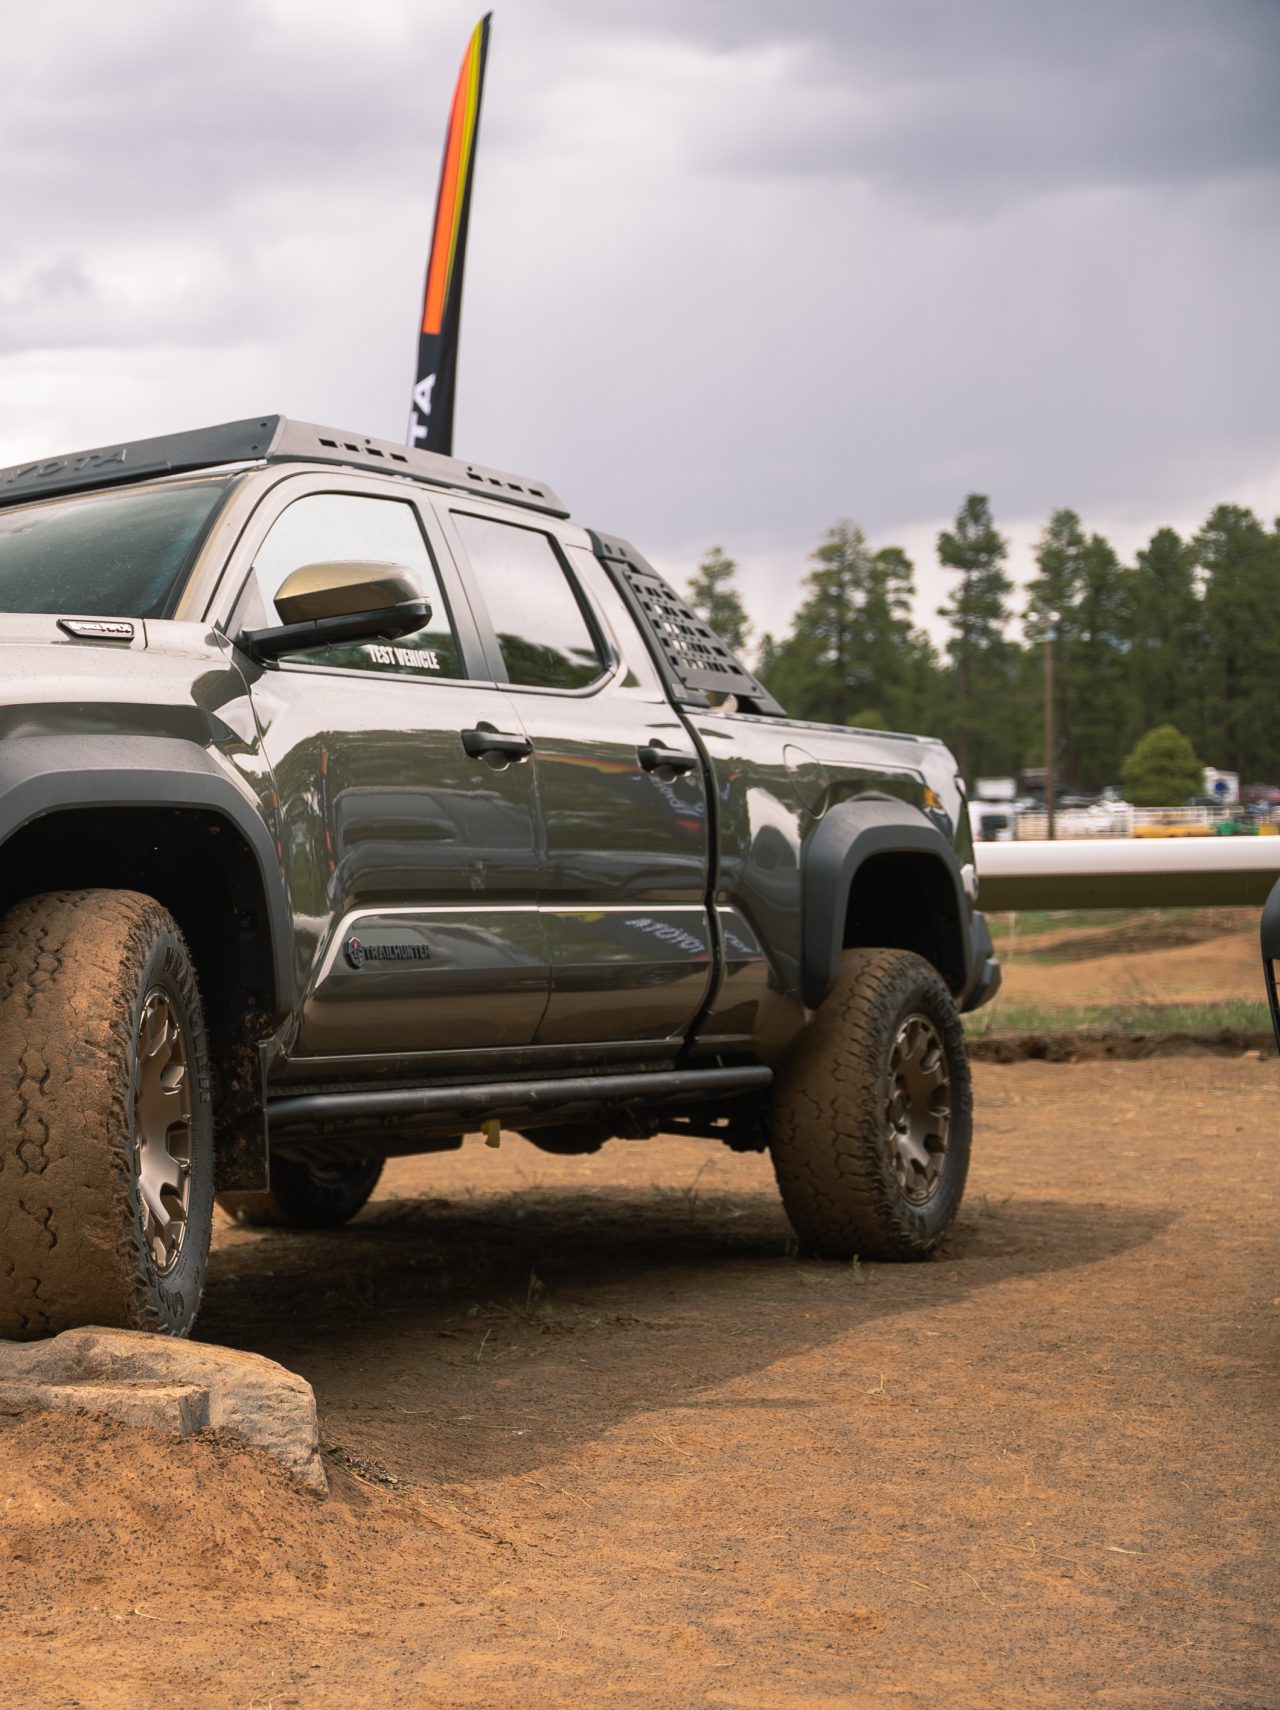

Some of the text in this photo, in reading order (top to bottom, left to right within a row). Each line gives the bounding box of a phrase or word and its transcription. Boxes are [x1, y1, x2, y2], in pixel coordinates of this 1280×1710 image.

[368, 643, 440, 669] TEST VEHICLE
[363, 944, 430, 961] TRAILHUNTER
